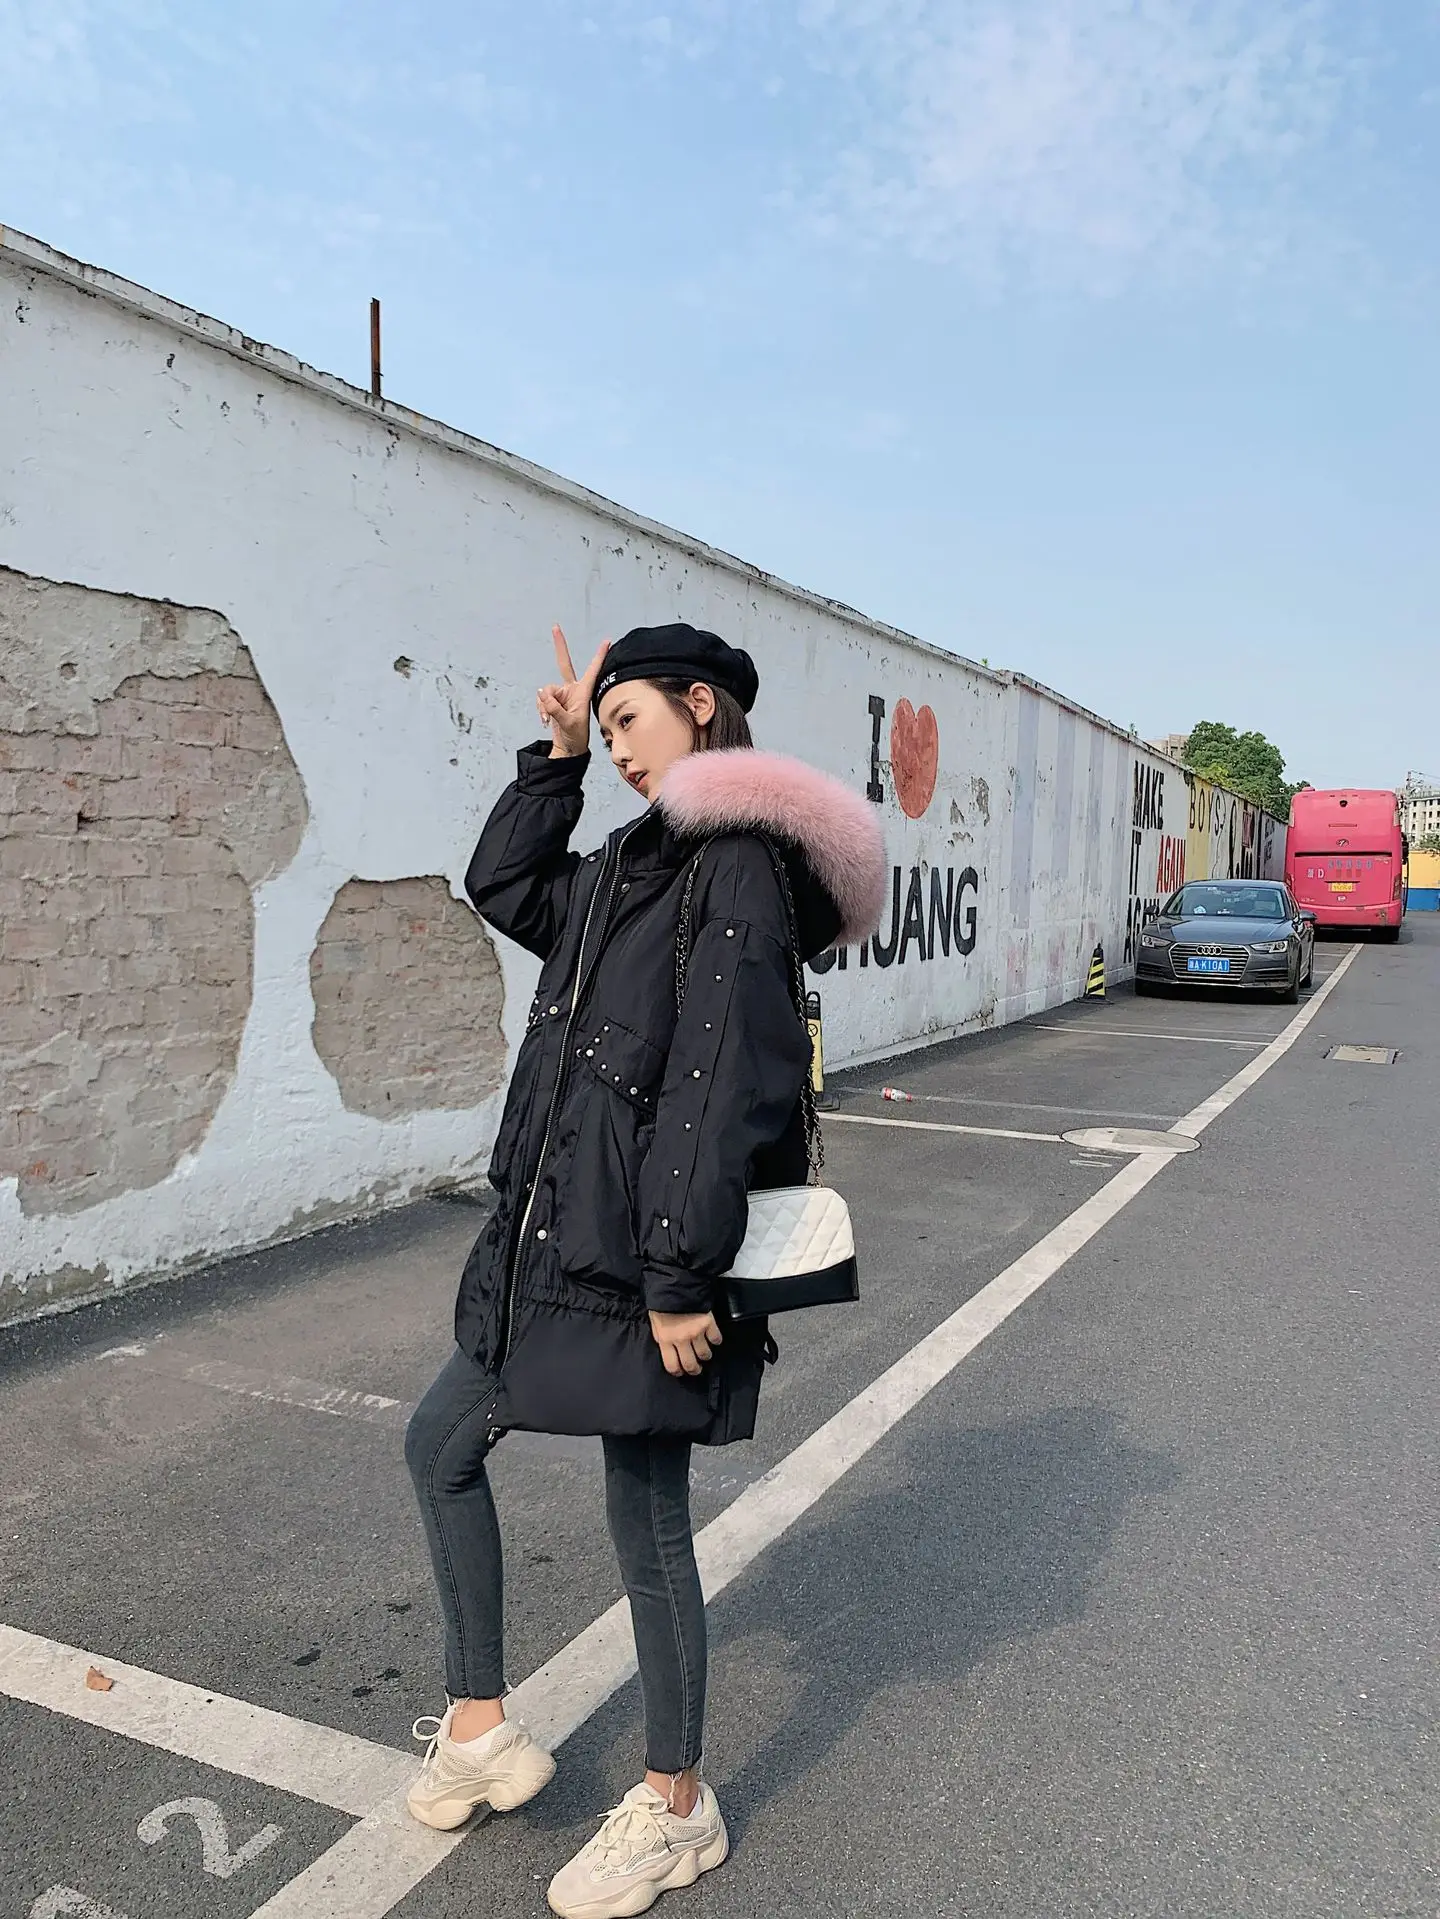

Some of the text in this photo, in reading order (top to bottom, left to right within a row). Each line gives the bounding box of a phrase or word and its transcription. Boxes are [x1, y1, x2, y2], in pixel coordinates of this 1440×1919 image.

[867, 694, 885, 803] I
[1133, 760, 1164, 830] MAKE
[1129, 829, 1142, 896] IT
[1156, 835, 1187, 894] AGAIN
[806, 866, 979, 975] UANG
